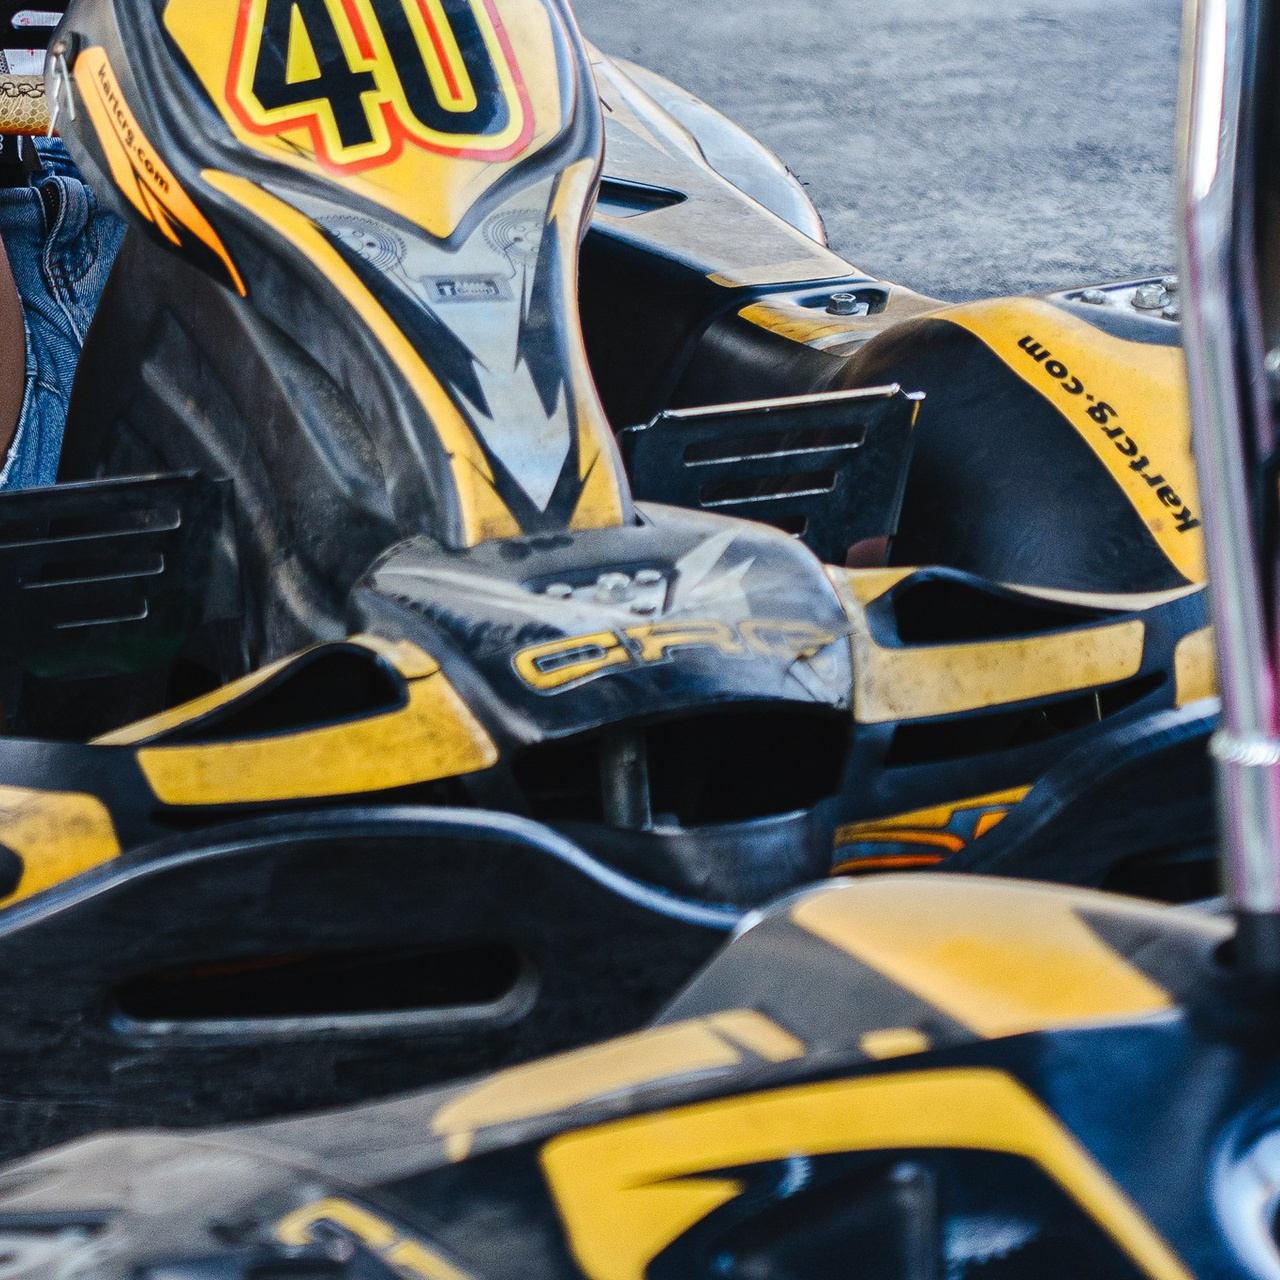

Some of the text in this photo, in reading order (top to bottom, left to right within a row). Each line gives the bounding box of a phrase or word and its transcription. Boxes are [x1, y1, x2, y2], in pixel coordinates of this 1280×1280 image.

[99, 62, 170, 194] kartcrg.com
[1017, 335, 1200, 533] kartcrg.com
[512, 620, 838, 694] CRG
